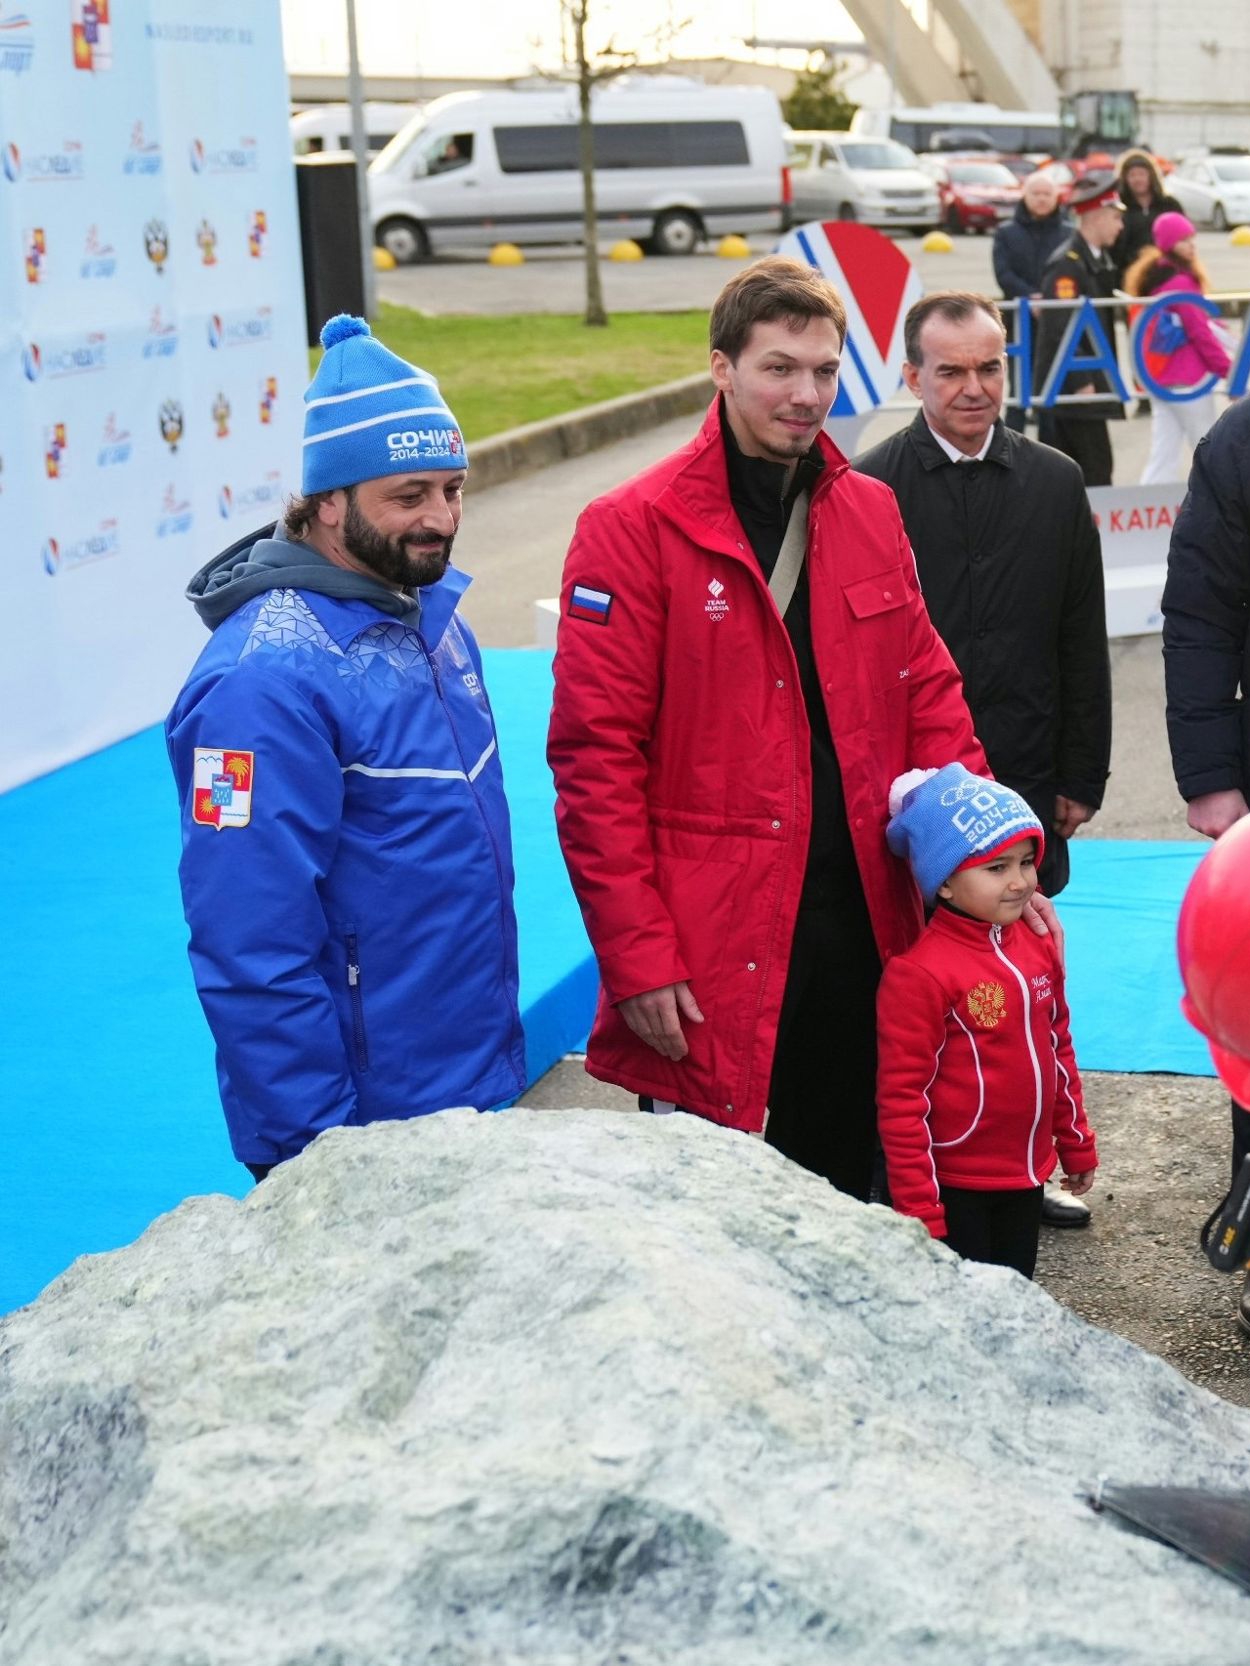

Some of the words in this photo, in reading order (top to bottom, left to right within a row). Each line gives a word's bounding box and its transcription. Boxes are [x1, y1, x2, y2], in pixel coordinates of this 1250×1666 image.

[387, 429, 450, 449] СОЧИ
[389, 446, 451, 462] 2014-2024
[1108, 504, 1182, 533] КАТА
[965, 798, 1029, 843] 2014-20
